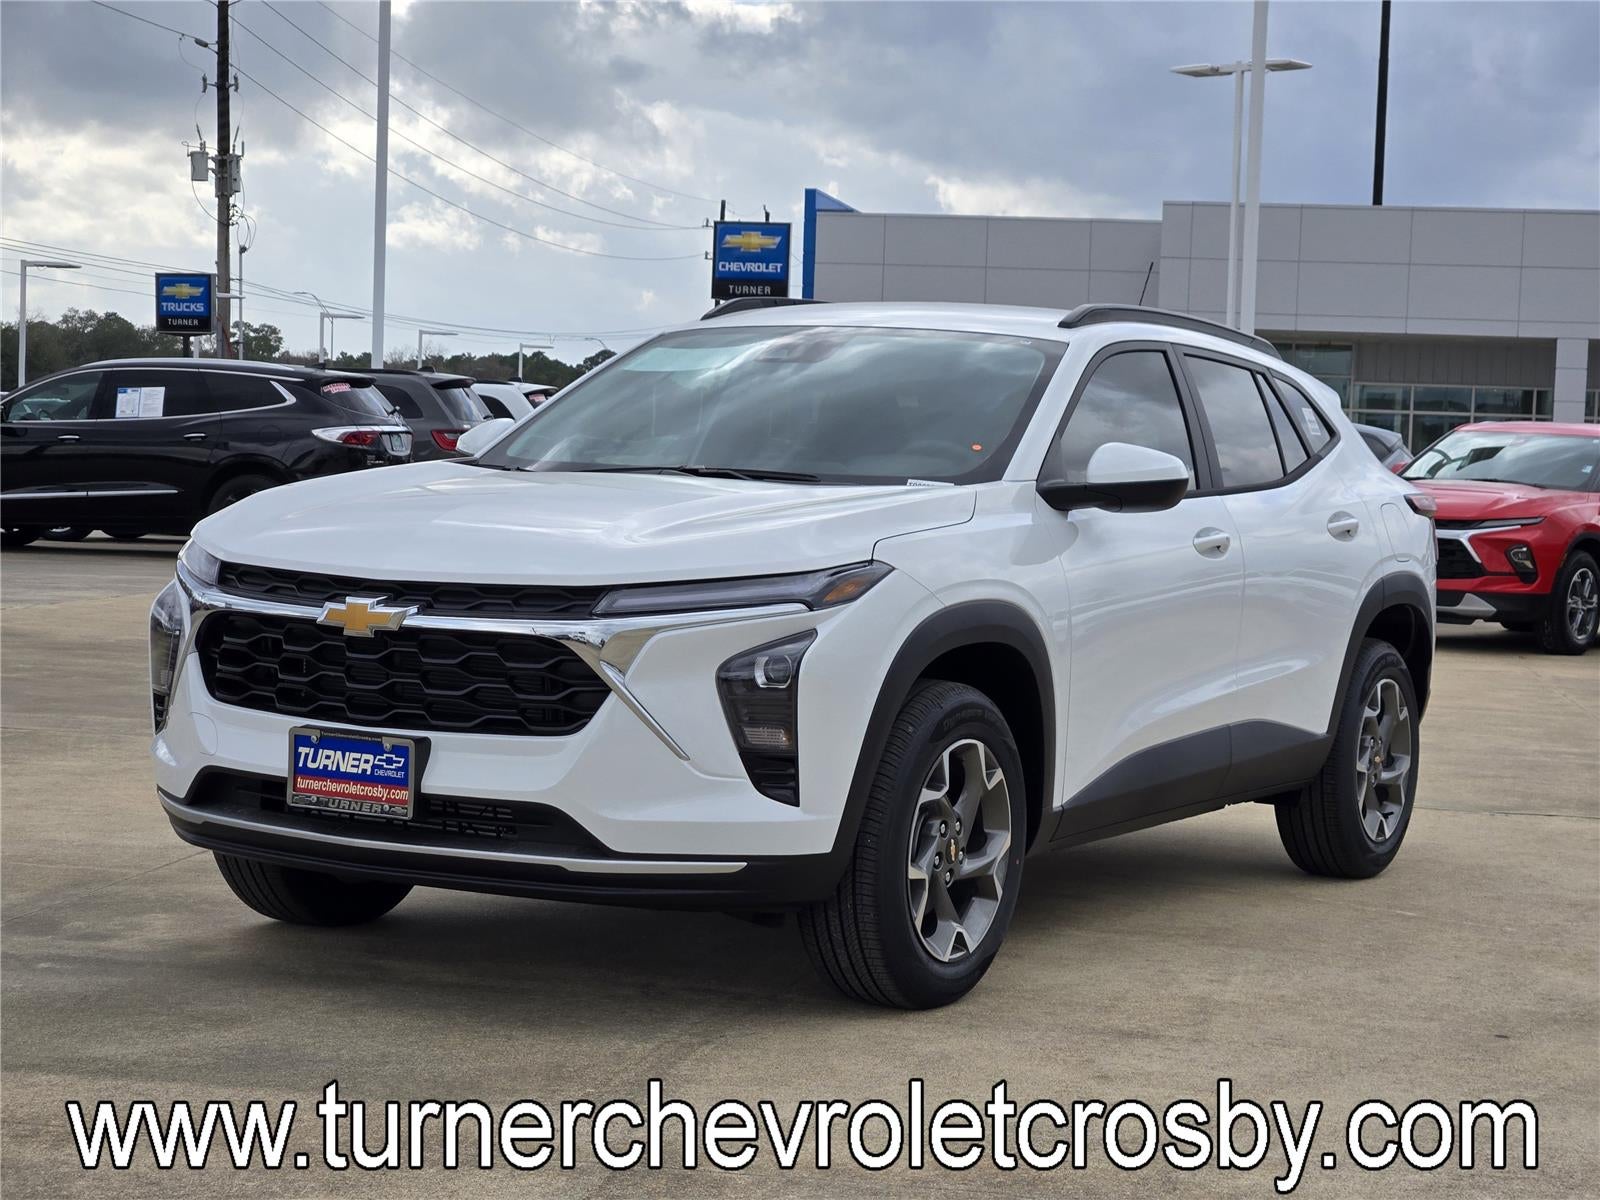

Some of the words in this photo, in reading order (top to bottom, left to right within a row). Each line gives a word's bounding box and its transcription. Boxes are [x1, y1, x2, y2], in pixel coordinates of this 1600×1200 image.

[718, 261, 783, 273] CHEVROLET
[729, 284, 771, 295] TURNER
[161, 302, 204, 312] TRUCKS
[167, 318, 199, 326] TURNER
[297, 746, 374, 775] TURNER
[374, 769, 405, 779] CHEVROLET
[297, 776, 409, 801] turnerchevroletcrosby.com
[320, 797, 382, 814] TURNER
